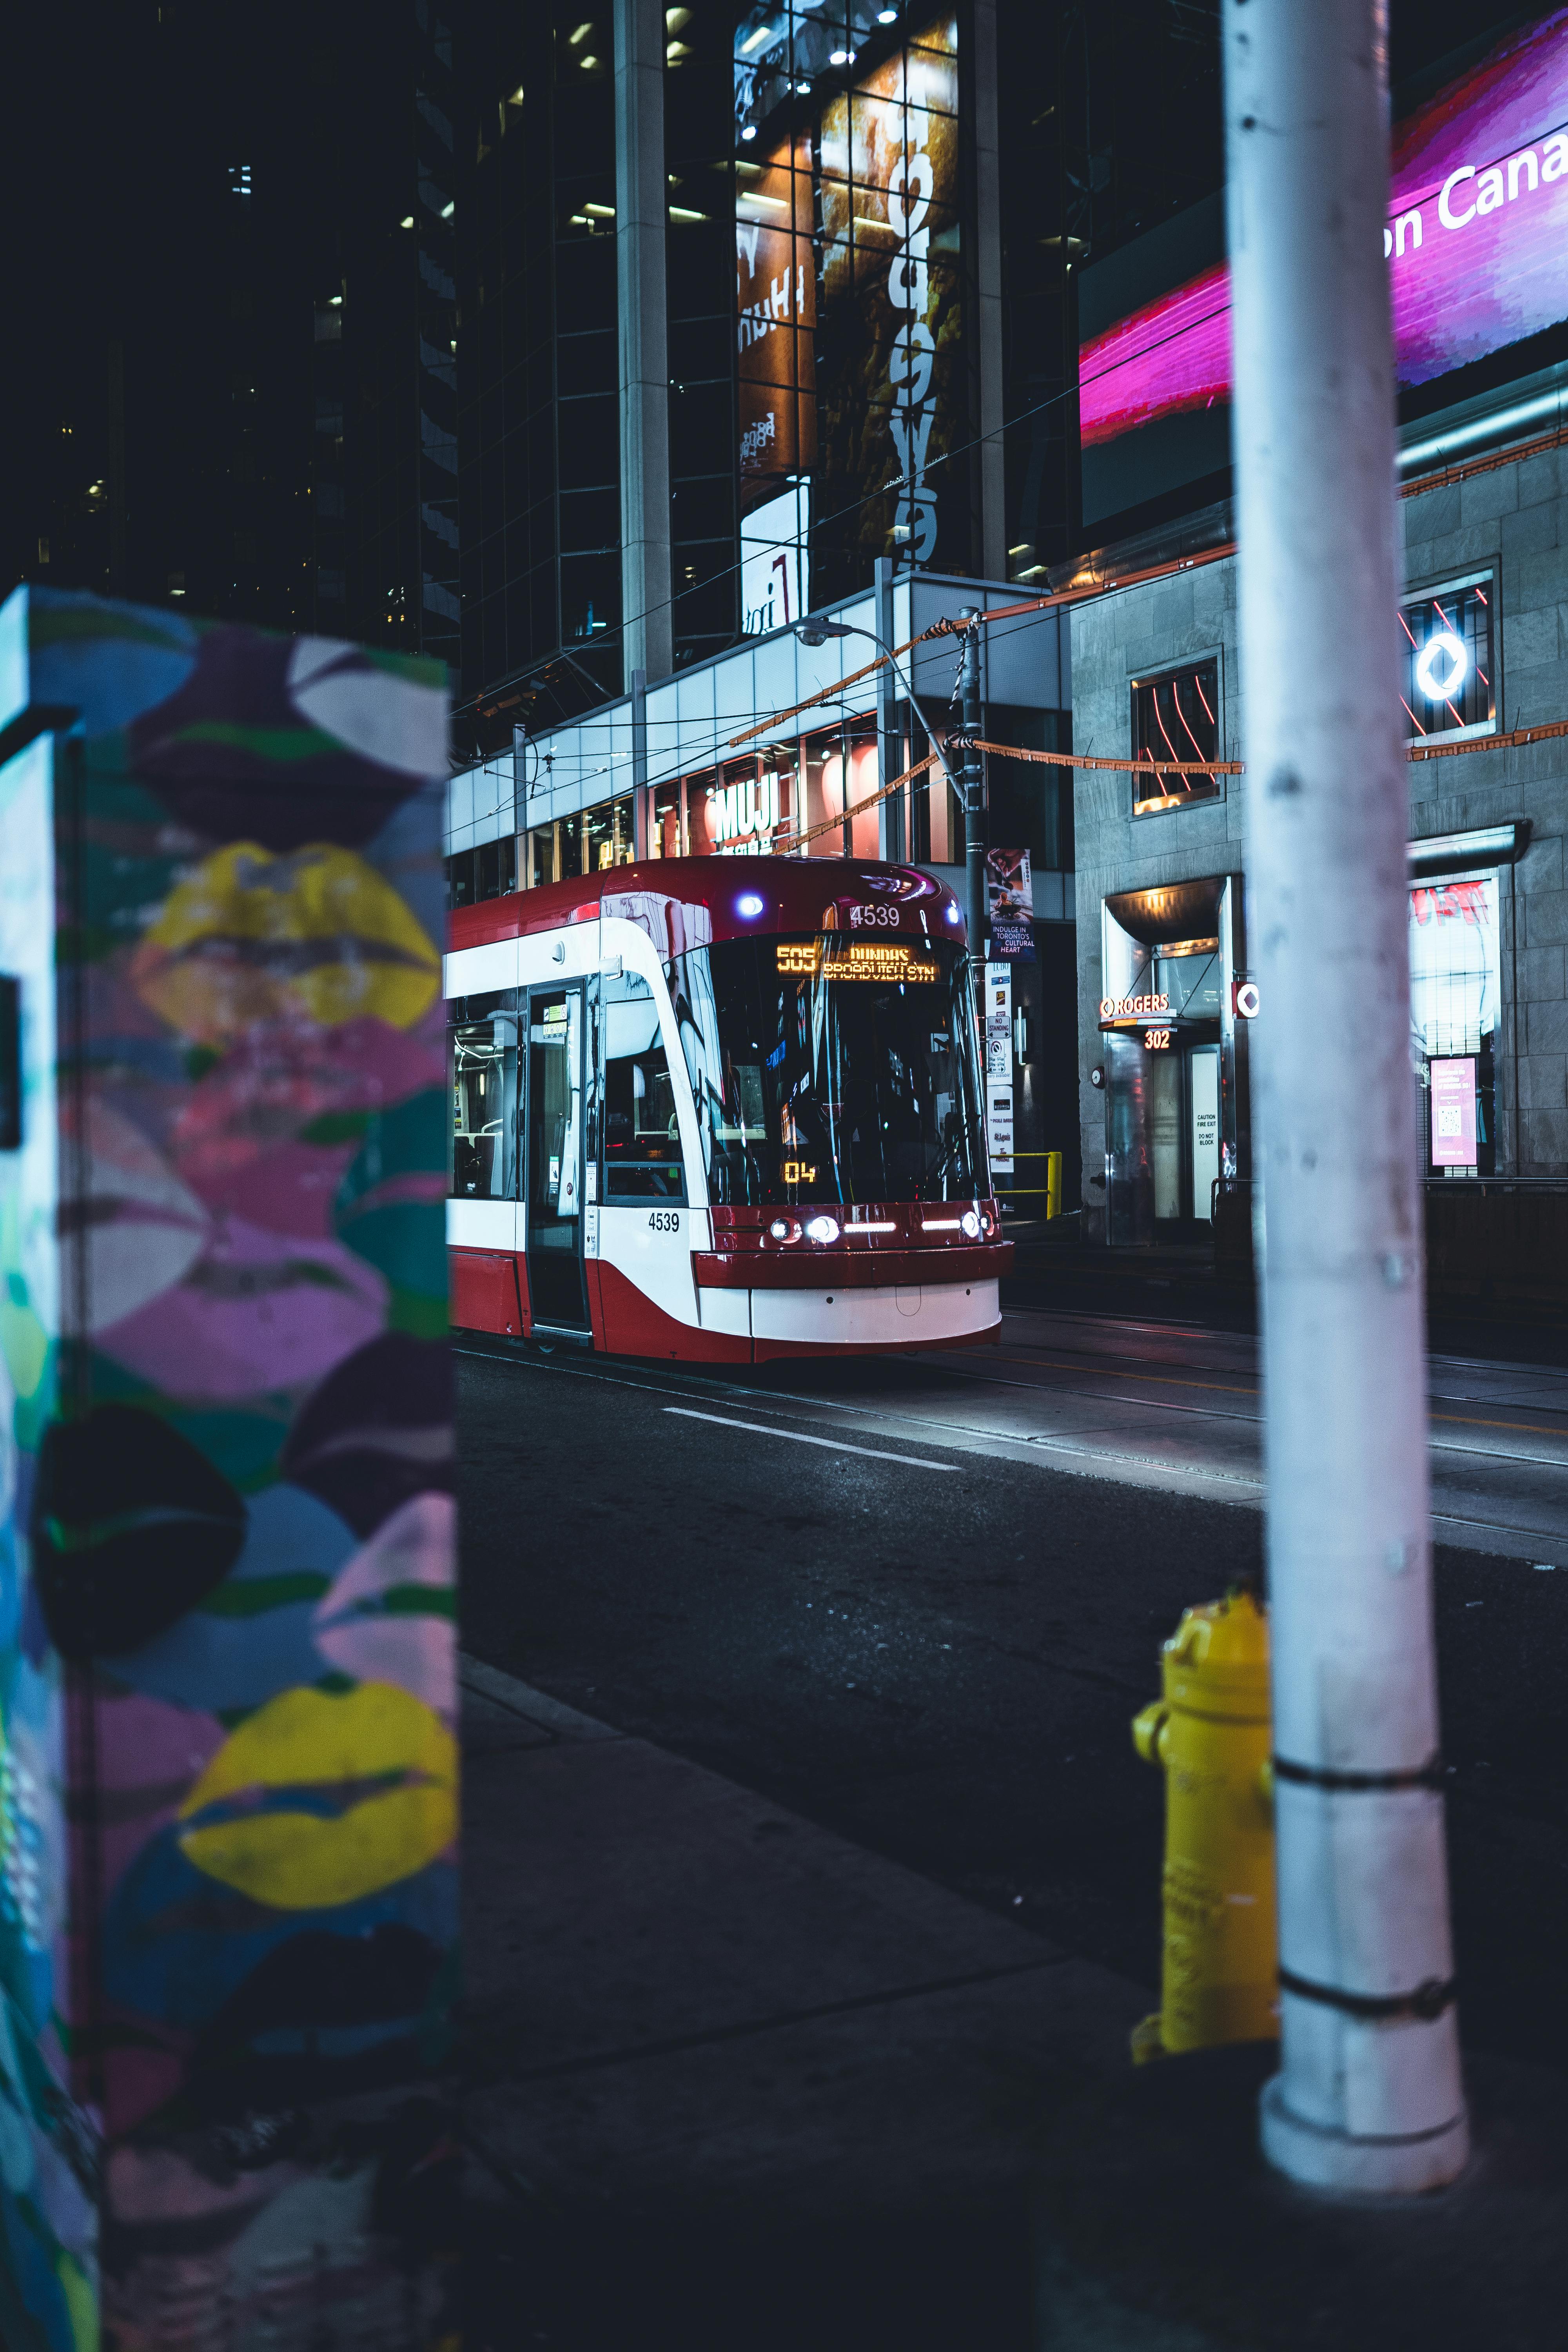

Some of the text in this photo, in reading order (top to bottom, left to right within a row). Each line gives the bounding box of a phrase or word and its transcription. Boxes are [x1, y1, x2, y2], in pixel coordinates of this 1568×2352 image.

[715, 771, 779, 843] MUJI
[850, 906, 899, 926] 4539
[777, 947, 816, 971] 505
[1116, 993, 1169, 1015] ROGERS
[1145, 1030, 1170, 1049] 302
[785, 1162, 815, 1183] 04
[648, 1212, 680, 1232] 4539
